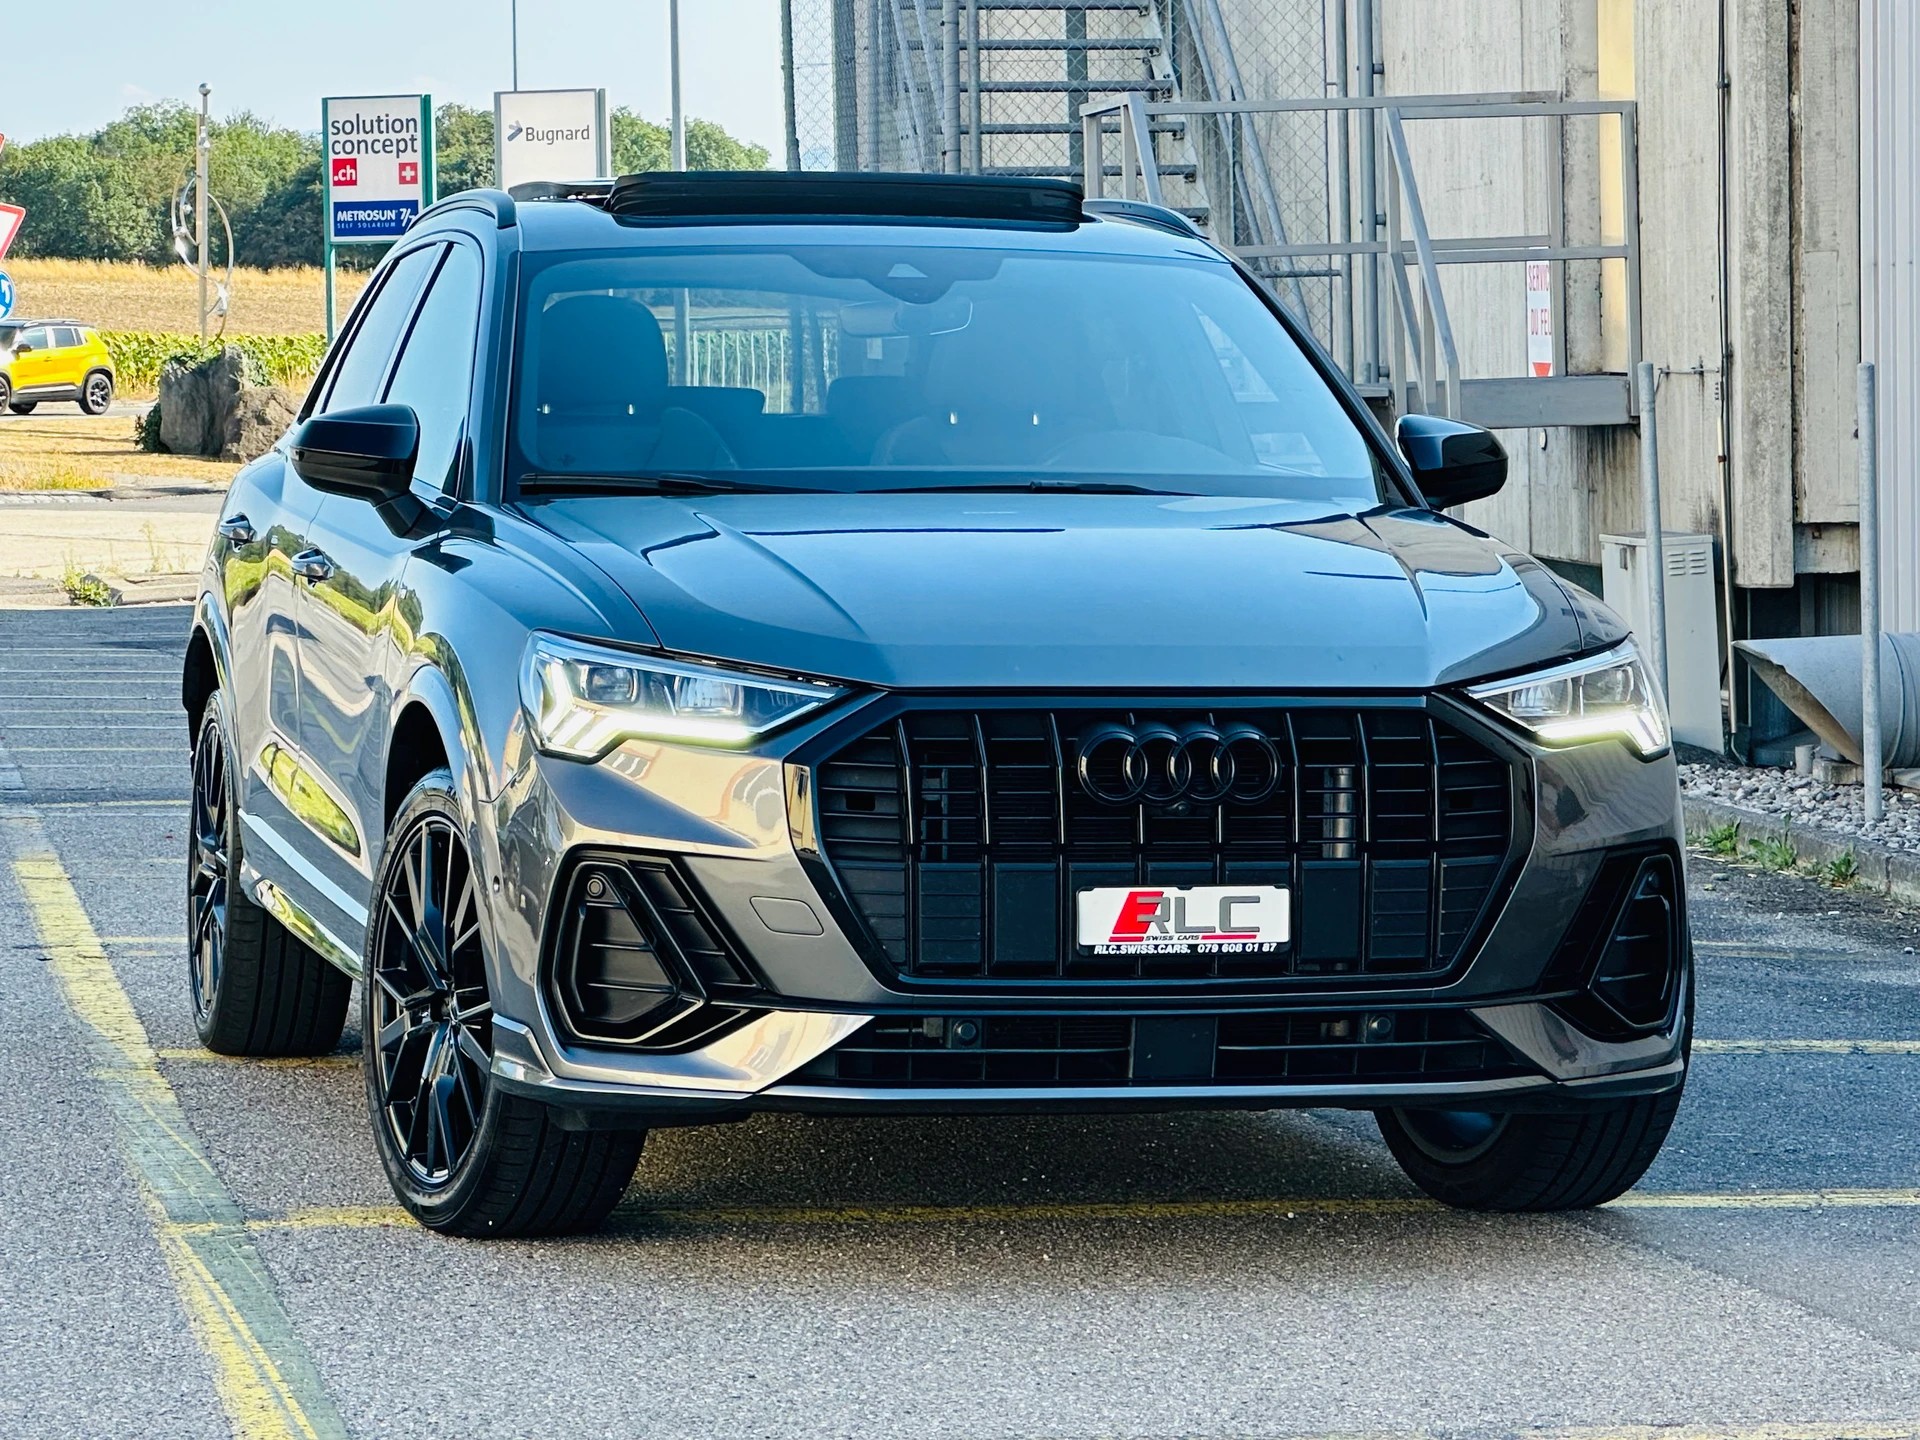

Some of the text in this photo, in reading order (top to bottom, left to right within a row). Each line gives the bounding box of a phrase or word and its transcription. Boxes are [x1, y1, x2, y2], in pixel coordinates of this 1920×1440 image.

[331, 113, 418, 136] solution
[525, 124, 590, 145] Bugnard
[331, 134, 418, 158] concept
[333, 164, 356, 181] .ch
[337, 209, 396, 222] METROSUN
[1528, 264, 1549, 291] SERVIC
[1093, 943, 1278, 955] RLC.SWISS.CARS. 079 608 01 87
